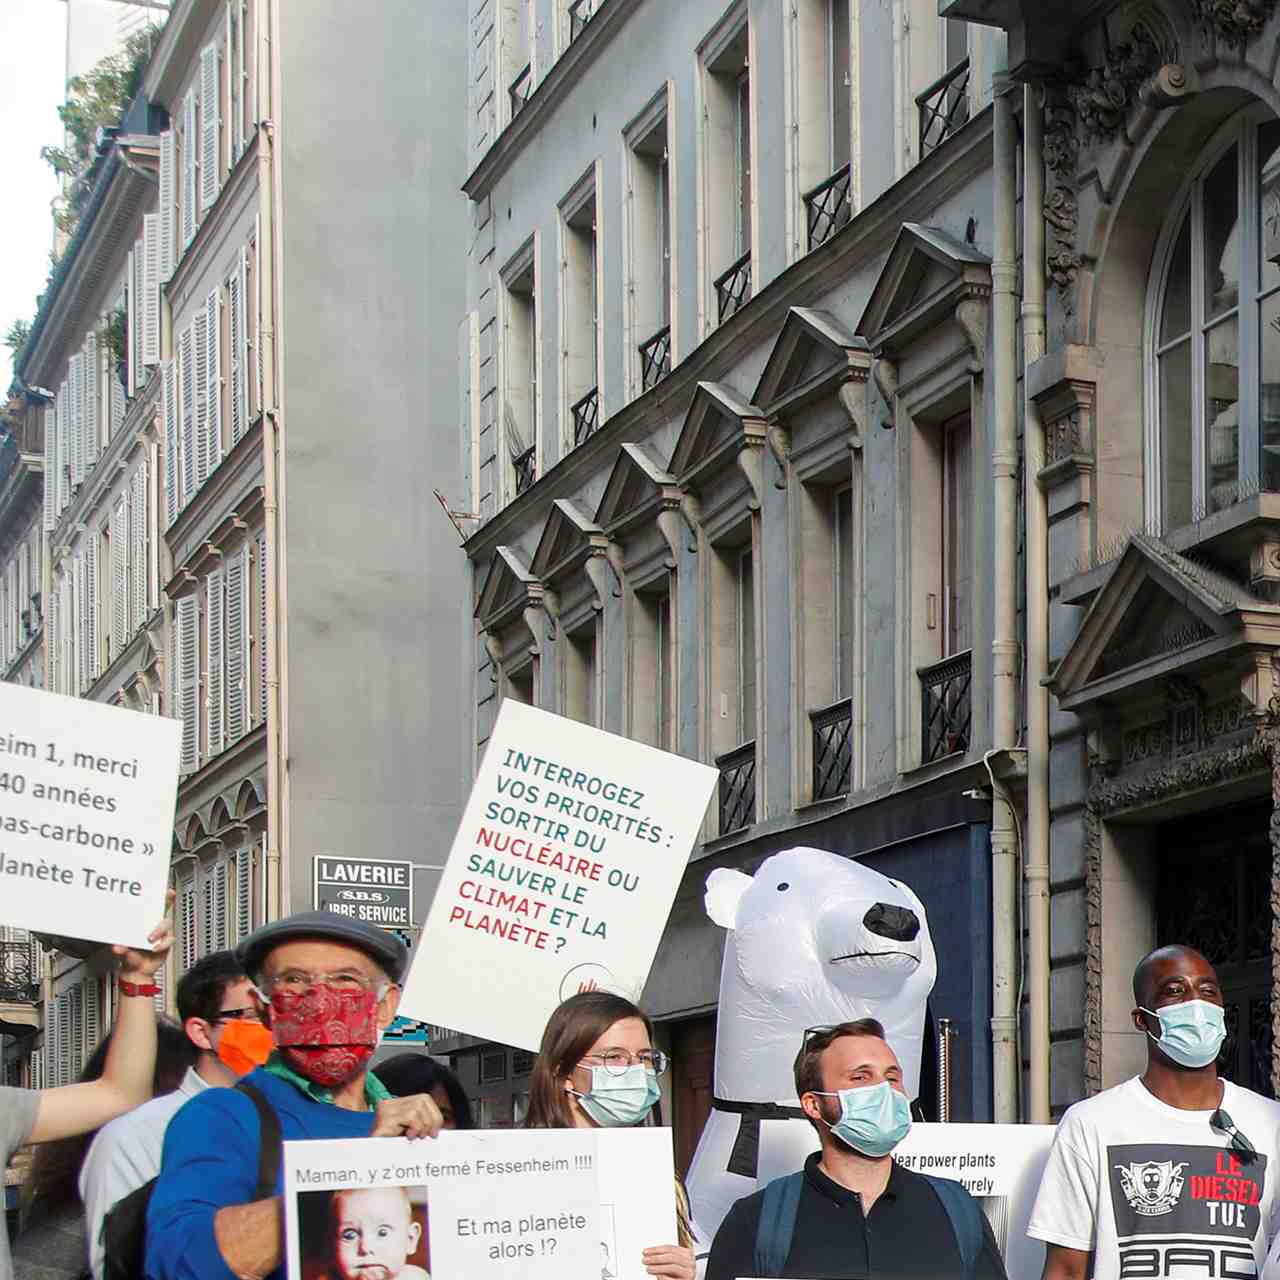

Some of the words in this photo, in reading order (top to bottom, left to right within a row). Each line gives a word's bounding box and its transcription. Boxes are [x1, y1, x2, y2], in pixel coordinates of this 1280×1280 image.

[45, 742, 65, 768] 1,
[73, 750, 138, 779] merci
[503, 749, 644, 809] INTERROGEZ
[32, 782, 117, 813] années
[496, 774, 541, 803] VOS
[545, 792, 663, 844] PRIORITÉS
[485, 802, 570, 842] SORTIR
[575, 830, 606, 853] DU
[322, 863, 405, 884] LAVERIE
[476, 827, 604, 881] NUCLÉAIRE
[607, 868, 640, 892] OU
[81, 867, 143, 896] Terre
[467, 853, 557, 896] SAUVER
[561, 882, 588, 905] LE
[359, 905, 408, 923] SERVICE
[459, 880, 546, 920] CLIMAT
[549, 907, 579, 930] ET
[582, 917, 608, 939] LA
[449, 905, 550, 950] PLANÈTE
[555, 937, 567, 954] ?
[295, 1166, 363, 1185] Maman,
[368, 1168, 378, 1184] y
[425, 1159, 471, 1178] fermé
[476, 1157, 569, 1175] Fessenheim
[920, 1154, 957, 1170] power
[959, 1152, 996, 1170] plants
[1216, 1151, 1243, 1177] LE
[456, 1217, 479, 1236] Et
[483, 1219, 513, 1235] ma
[518, 1212, 587, 1237] planète
[1206, 1201, 1246, 1228] TUE
[488, 1240, 535, 1260] alors
[540, 1238, 557, 1256] !?
